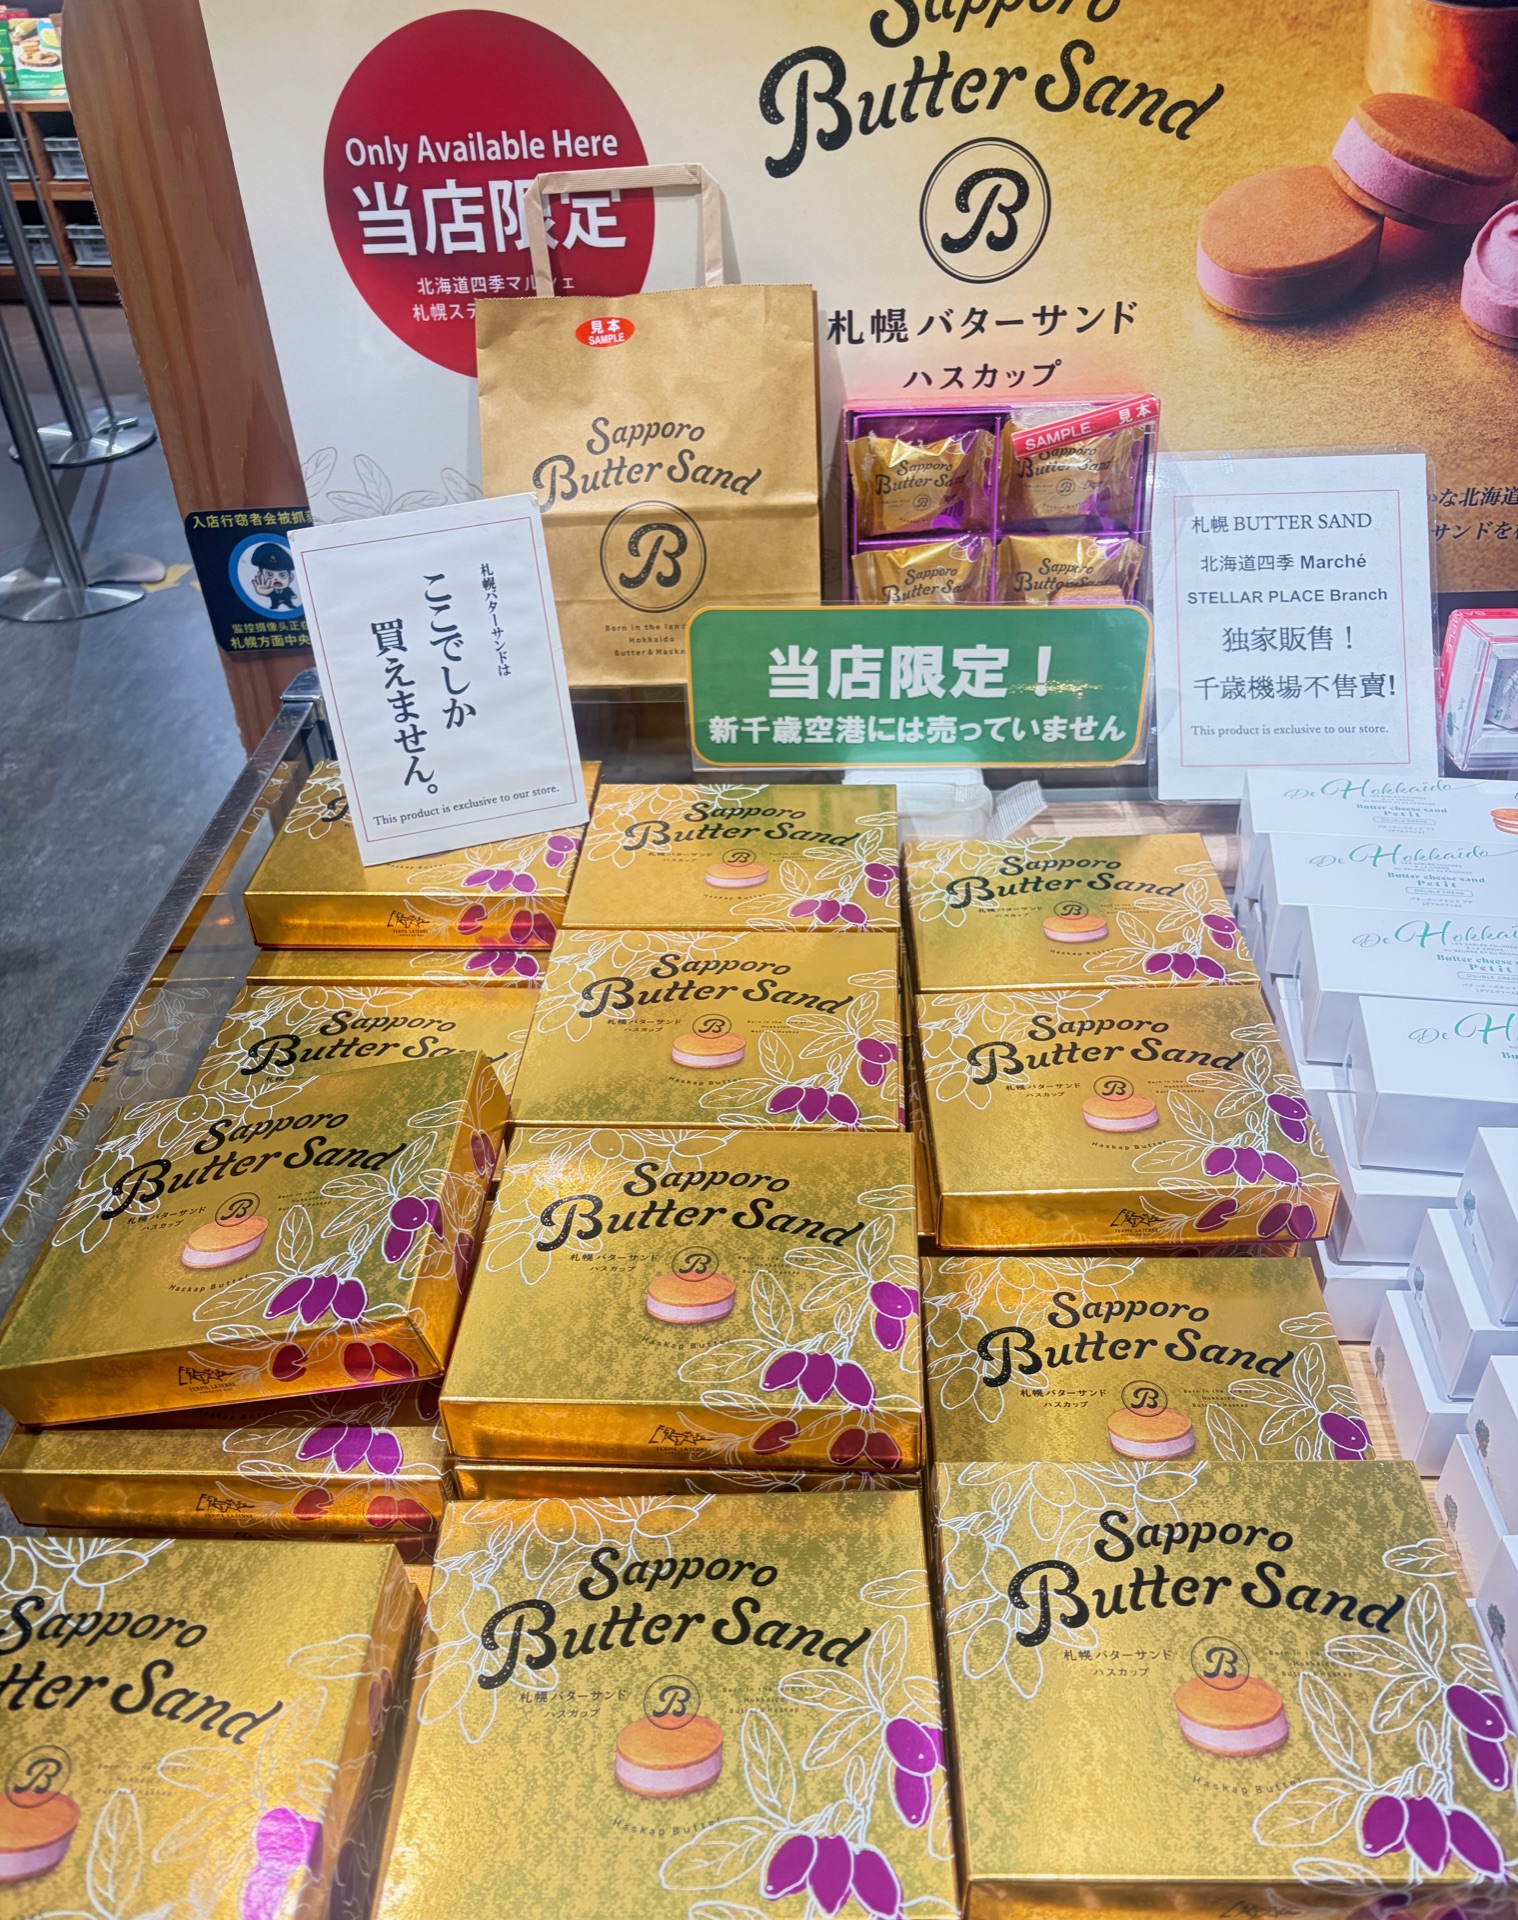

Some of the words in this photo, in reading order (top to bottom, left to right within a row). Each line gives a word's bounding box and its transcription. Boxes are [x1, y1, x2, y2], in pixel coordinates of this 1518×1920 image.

[759, 46, 1027, 179] Butter
[1034, 39, 1225, 141] Sand
[345, 135, 408, 173] Only
[417, 129, 546, 163] Available
[552, 129, 618, 158] Here
[352, 179, 627, 256] 当店限定
[940, 167, 1030, 254] B
[588, 333, 625, 345] SAMPLE
[591, 319, 621, 334] 見本
[827, 301, 1138, 345] 札幌バターサンド
[903, 359, 1062, 390] ハスカップ
[586, 417, 705, 455] Sapporo
[1025, 421, 1092, 451] SAMPLE
[1118, 402, 1152, 426] 見本
[532, 454, 663, 513] Butter
[667, 449, 762, 496] Sand
[875, 474, 932, 496] Butter
[896, 460, 953, 476] Sapporo
[1191, 515, 1229, 533] 札幌
[1232, 514, 1314, 531] BUTTER
[1318, 513, 1372, 529] SAND
[904, 568, 957, 585] Sapporo
[1039, 558, 1094, 575] Sapporo
[1200, 554, 1294, 572] 北海道四季
[1300, 553, 1367, 569] Marché
[1187, 591, 1263, 604] STELLAR
[1268, 589, 1325, 602] PLACE
[1330, 588, 1388, 602] Branch
[480, 563, 511, 677] 札幌バターサンドは
[423, 573, 476, 729] ここでしか
[768, 645, 1052, 700] 当店限定！
[371, 618, 438, 794] 買えません。
[708, 715, 1127, 744] 新千歳空港には売っていません
[1191, 725, 1215, 736] This
[1218, 725, 1259, 738] product
[1262, 725, 1271, 735] is
[1273, 724, 1321, 735] exclusive
[1324, 726, 1335, 734] to
[1338, 726, 1356, 734] our
[1359, 724, 1389, 734] store.
[373, 813, 397, 826] This
[400, 808, 440, 825] product
[443, 804, 451, 814] is
[453, 794, 498, 811] exclusive
[500, 792, 511, 802] to
[513, 791, 529, 800] our
[532, 784, 560, 798] store.
[684, 802, 806, 822] Sapporo
[623, 820, 761, 851] Butter
[764, 822, 860, 848] Sand
[1000, 856, 1121, 876] Sapporo
[948, 875, 1081, 909] Butter
[1087, 872, 1185, 897] Sand
[650, 954, 791, 979] Sapporo
[1437, 954, 1472, 963] Butter
[1469, 963, 1512, 973] Petit
[579, 977, 739, 1018] Butter
[742, 978, 855, 1014] Sand
[320, 1011, 457, 1036] Sapporo
[1027, 1015, 1169, 1041] Sapporo
[241, 1034, 401, 1075] Butter
[967, 1041, 1124, 1085] Butter
[1130, 1037, 1247, 1071] Sand
[194, 1109, 349, 1156] Sapporo
[100, 1149, 281, 1221] Butter
[285, 1136, 407, 1172] Sand
[623, 1162, 790, 1196] Sapporo
[536, 1193, 727, 1252] Butter
[732, 1197, 865, 1246] Sand
[1048, 1291, 1209, 1328] Sapporo
[977, 1326, 1159, 1387] Butter
[1165, 1327, 1295, 1378] Sand
[1020, 1388, 1107, 1398] 札幌バターサンド
[1044, 1400, 1088, 1408] ハスカップ
[1094, 1510, 1294, 1563] Sapporo
[579, 1547, 778, 1600] Sapporo
[1008, 1560, 1231, 1647] Butter
[1241, 1561, 1405, 1634] Sand
[0, 1596, 208, 1656] Sapporo
[477, 1599, 706, 1689] Butter
[712, 1596, 872, 1667] Sand
[1063, 1649, 1172, 1661] 札幌バターサンド
[1093, 1667, 1149, 1677] ハスカップ
[110, 1659, 283, 1744] Sand
[520, 1690, 627, 1704] 札幌バターサンド
[543, 1708, 600, 1719] ハスカップ
